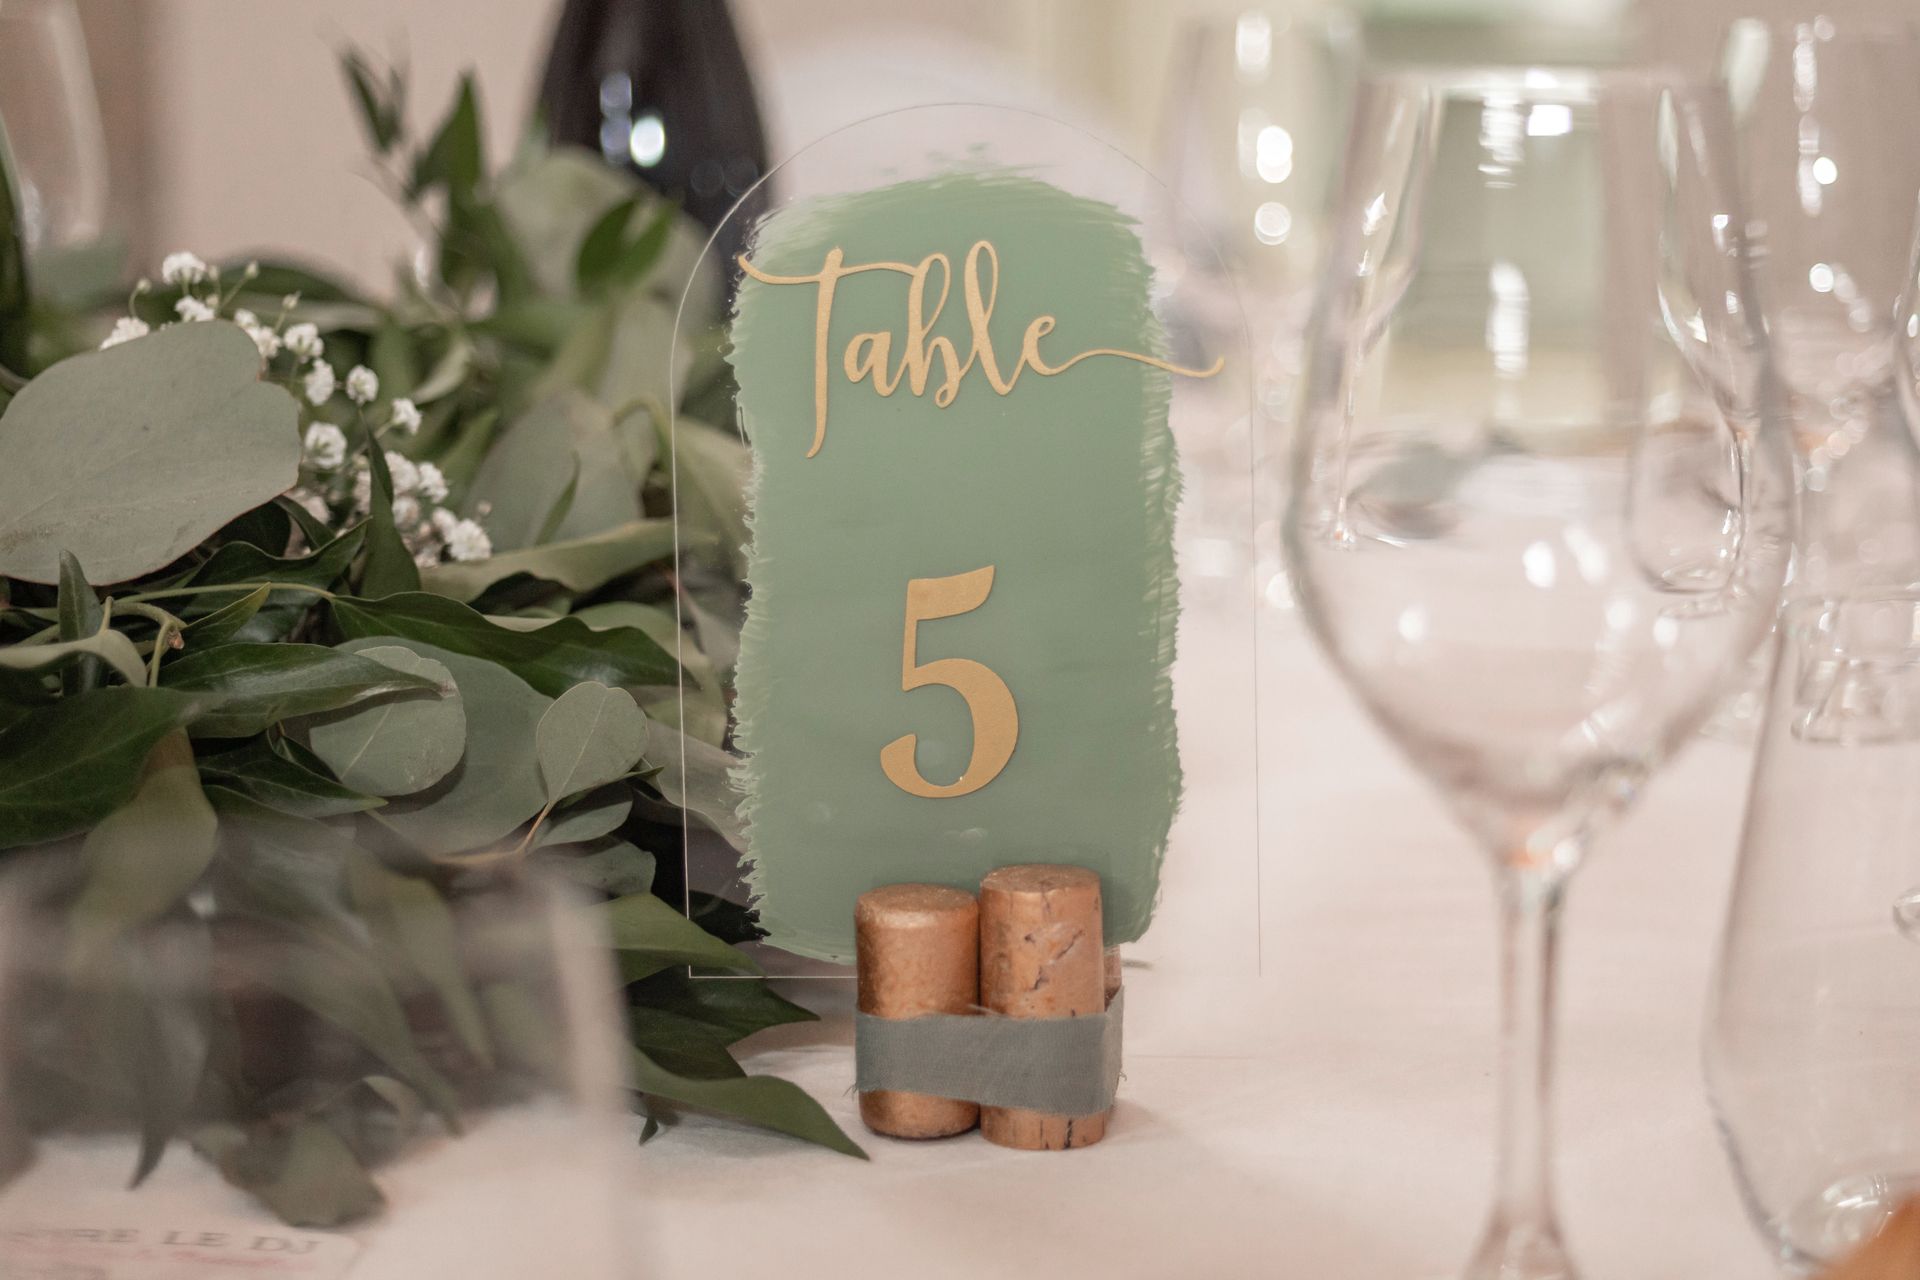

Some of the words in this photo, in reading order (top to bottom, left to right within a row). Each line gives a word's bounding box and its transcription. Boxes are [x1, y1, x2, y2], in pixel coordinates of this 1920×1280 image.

[738, 240, 1225, 460] Table
[879, 564, 1019, 799] 5
[162, 1230, 230, 1248] LE
[248, 1235, 323, 1255] DJ
